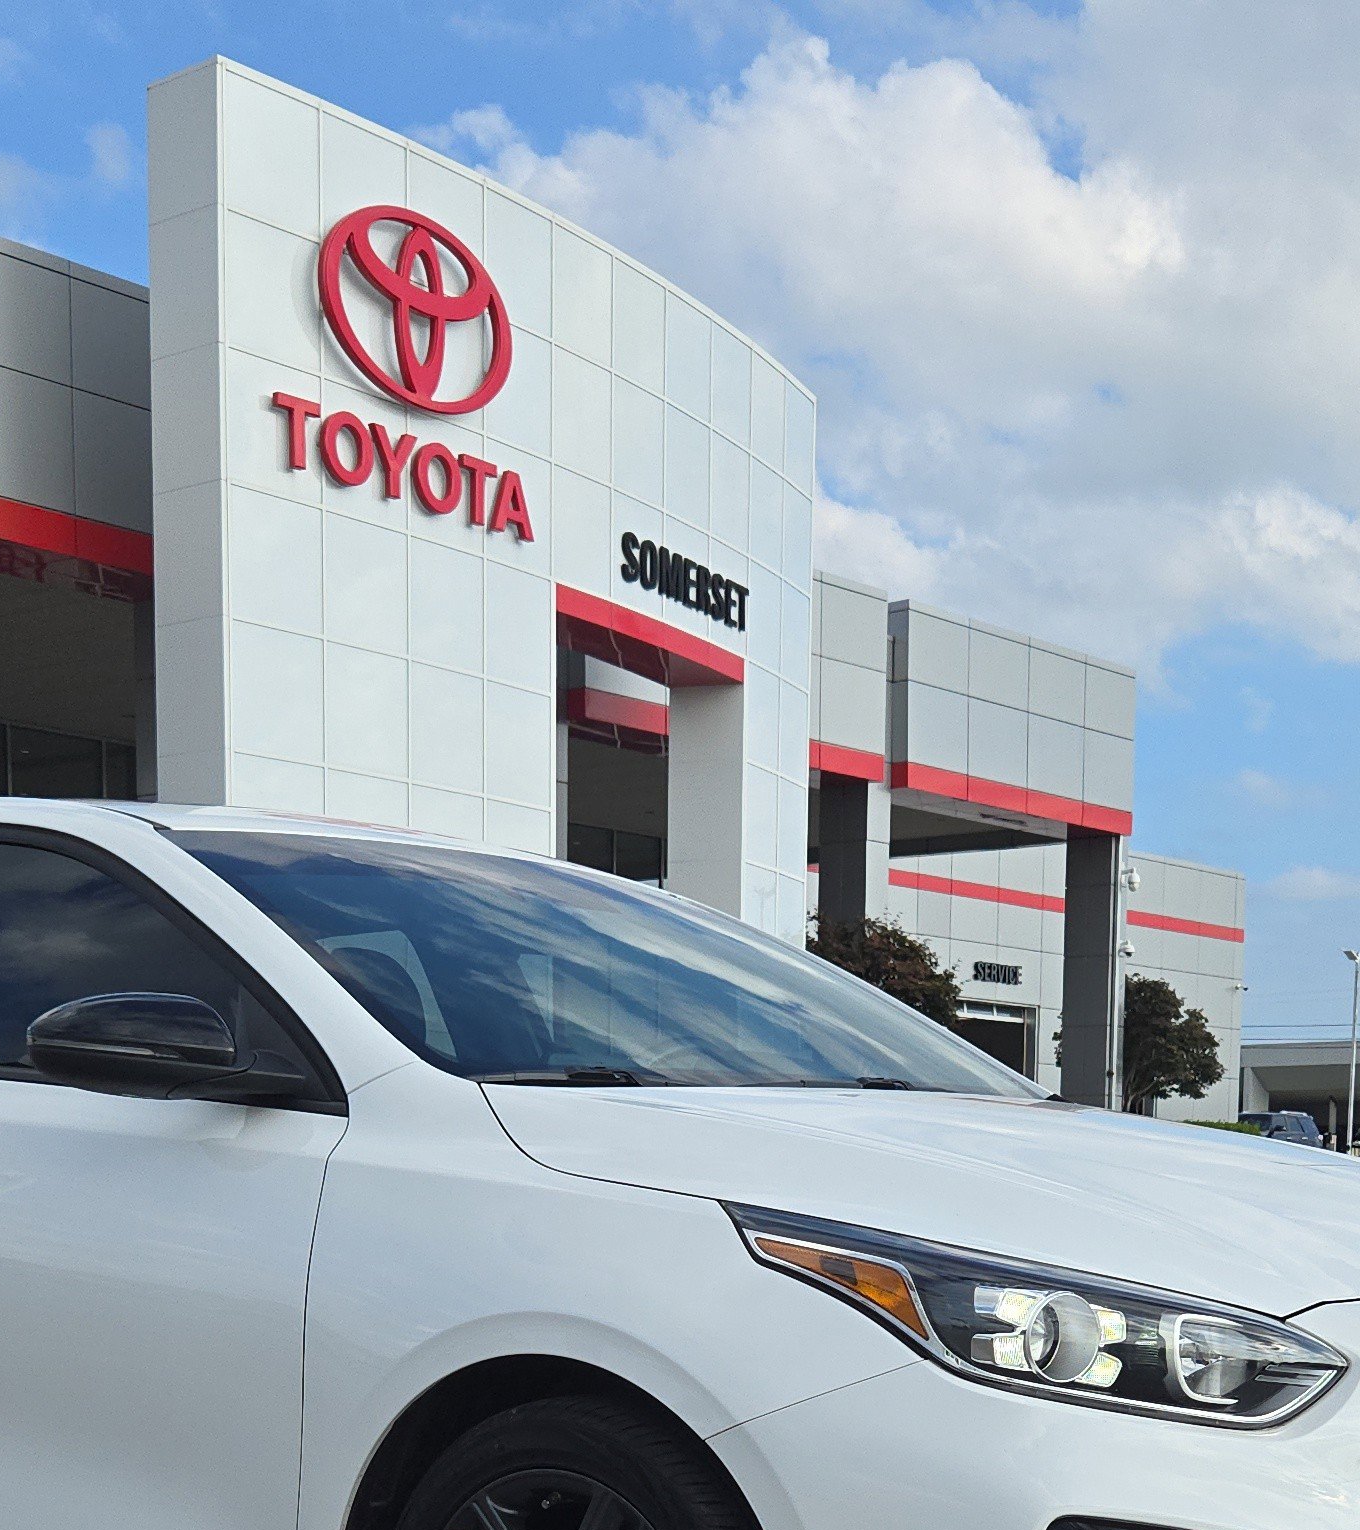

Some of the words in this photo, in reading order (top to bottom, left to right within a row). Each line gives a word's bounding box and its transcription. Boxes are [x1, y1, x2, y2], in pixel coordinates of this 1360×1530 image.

[272, 391, 534, 542] TOYOTA
[621, 531, 750, 632] SOMERSET
[973, 961, 1022, 985] SERVICE
